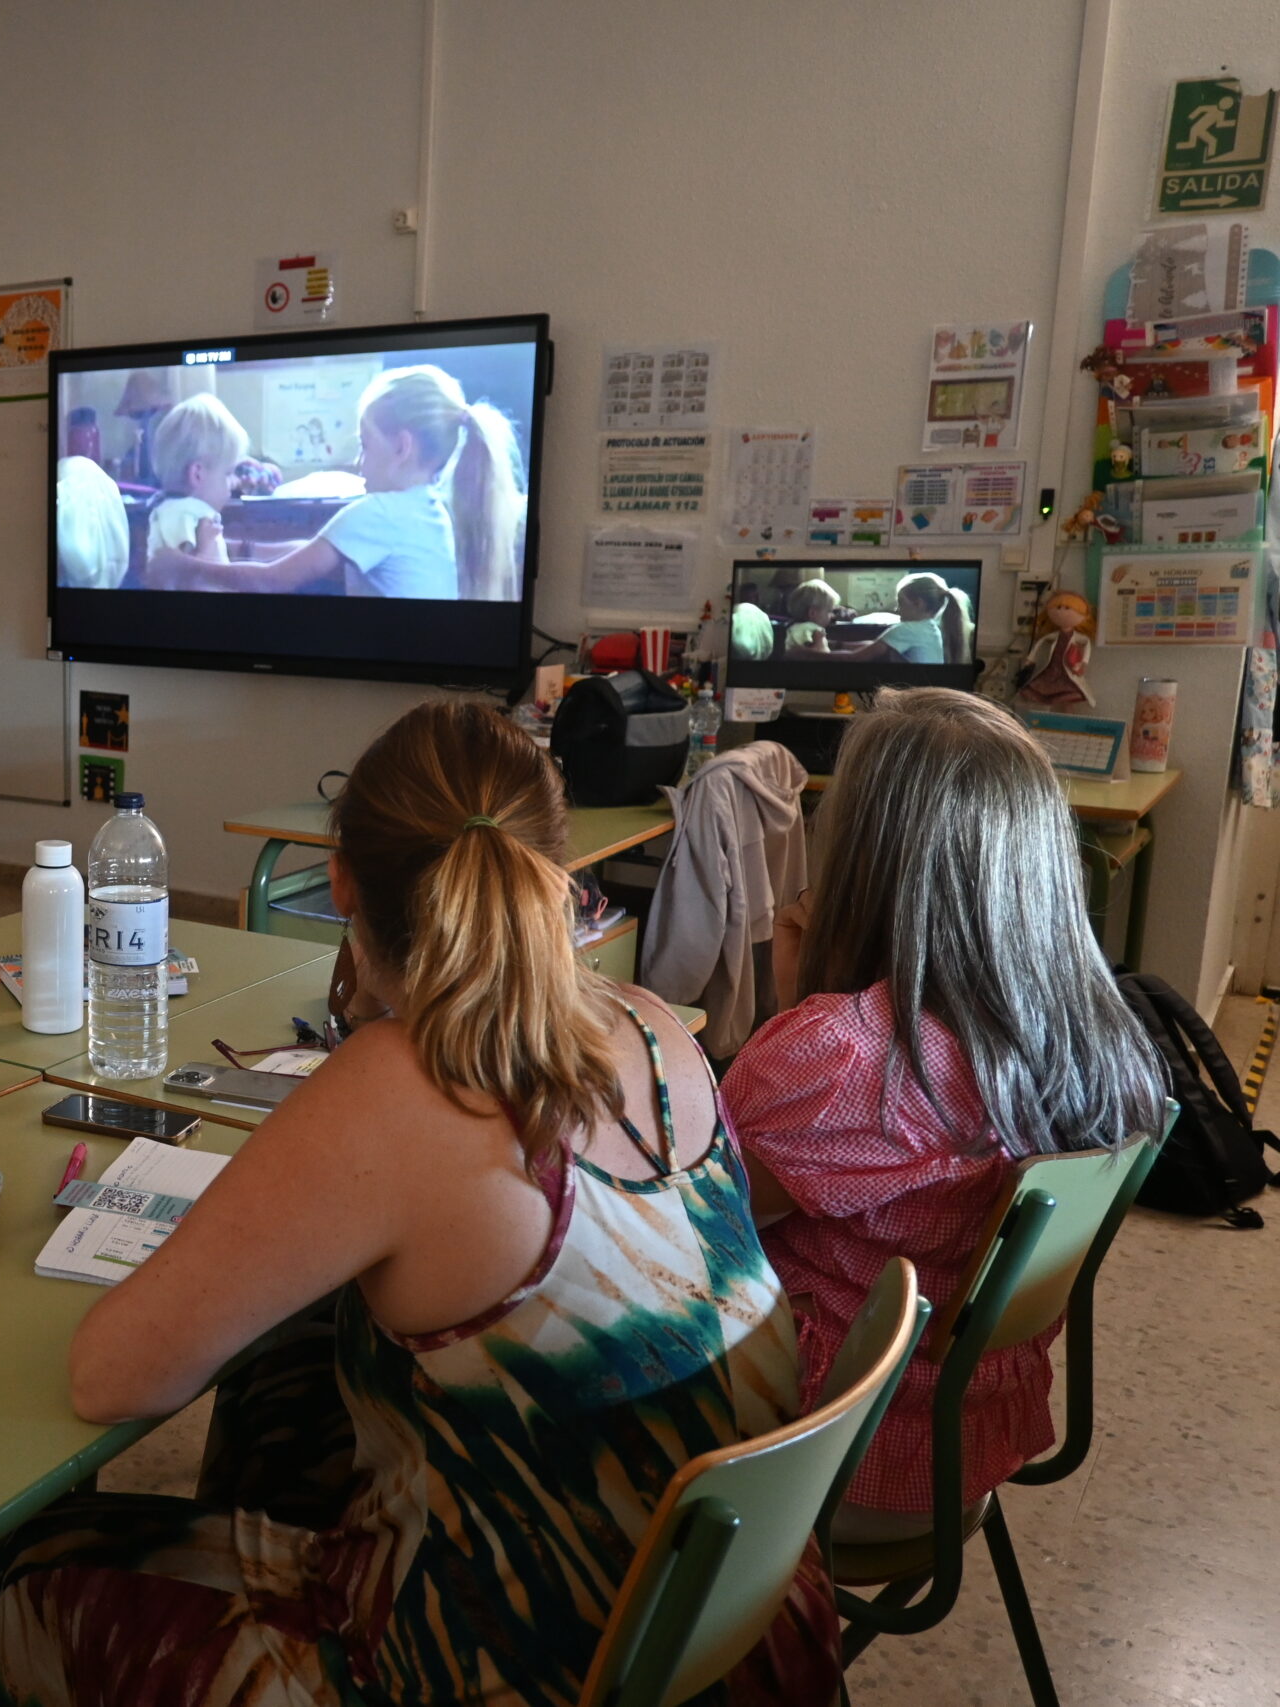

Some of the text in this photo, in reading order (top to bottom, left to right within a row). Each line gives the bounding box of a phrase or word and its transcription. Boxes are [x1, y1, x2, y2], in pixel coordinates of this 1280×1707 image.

[1165, 173, 1261, 195] SALIDA
[607, 438, 650, 448] PROTOCOLO
[663, 435, 705, 447] ACTUACIÓN
[617, 501, 671, 511] LLAMAR
[675, 501, 699, 511] 112
